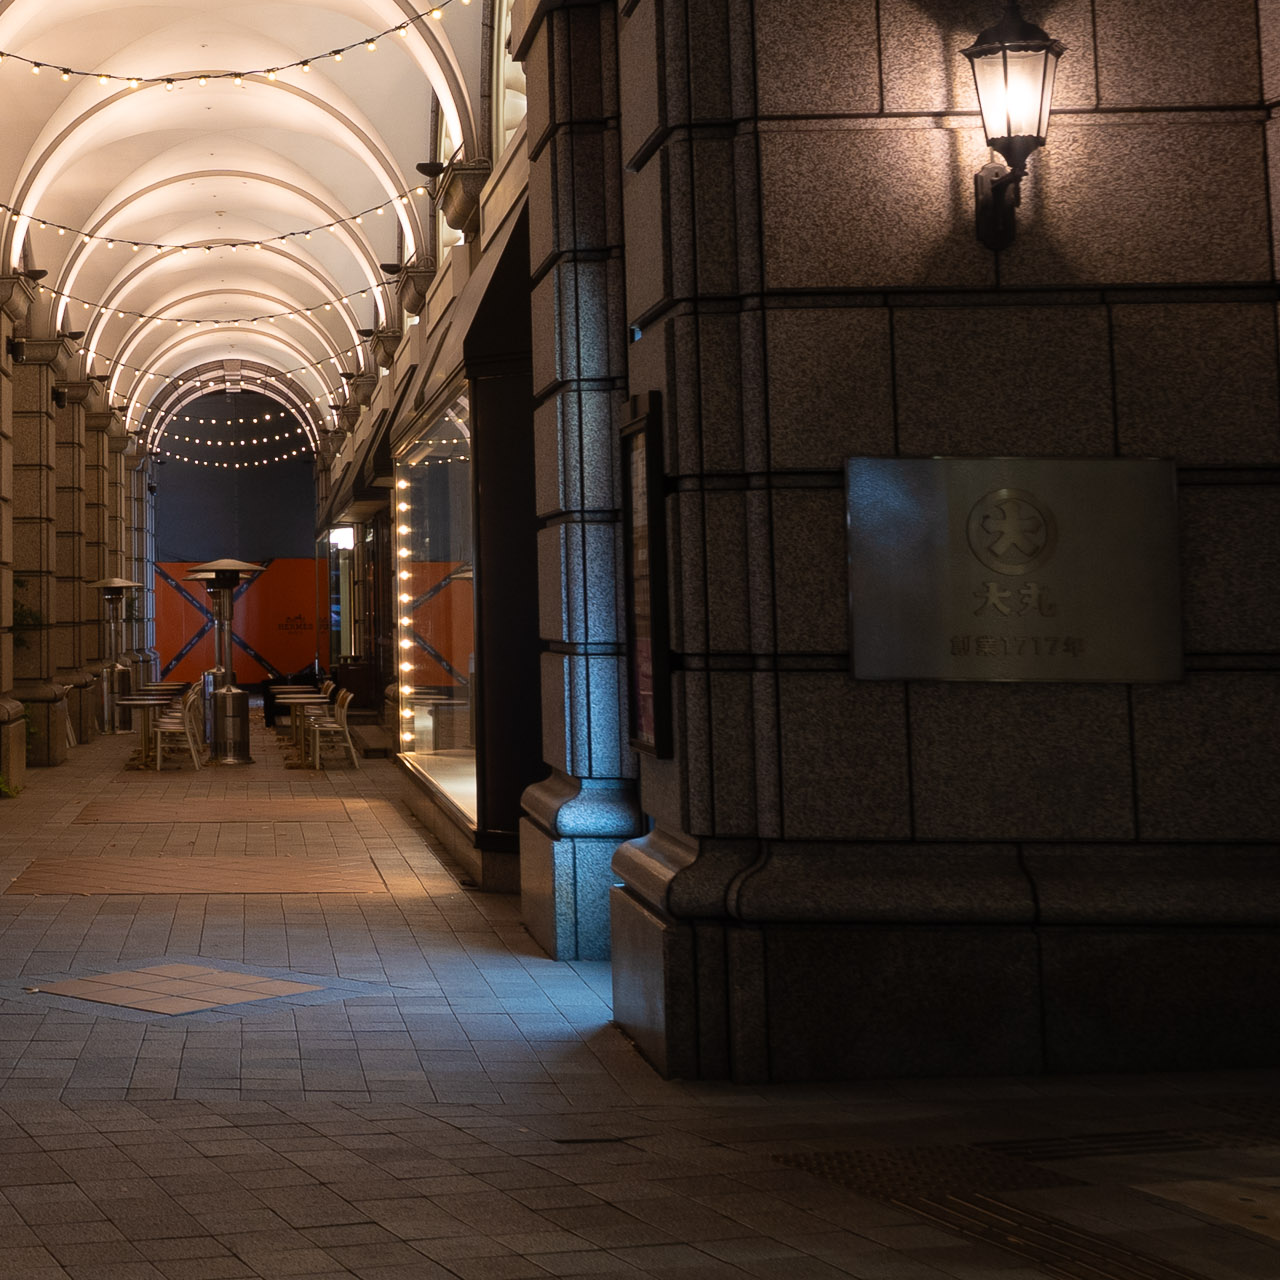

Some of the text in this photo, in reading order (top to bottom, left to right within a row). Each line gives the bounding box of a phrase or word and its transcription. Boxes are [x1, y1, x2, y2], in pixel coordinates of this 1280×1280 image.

[972, 581, 1057, 617] 大丸
[949, 634, 1087, 658] 創業1717年
